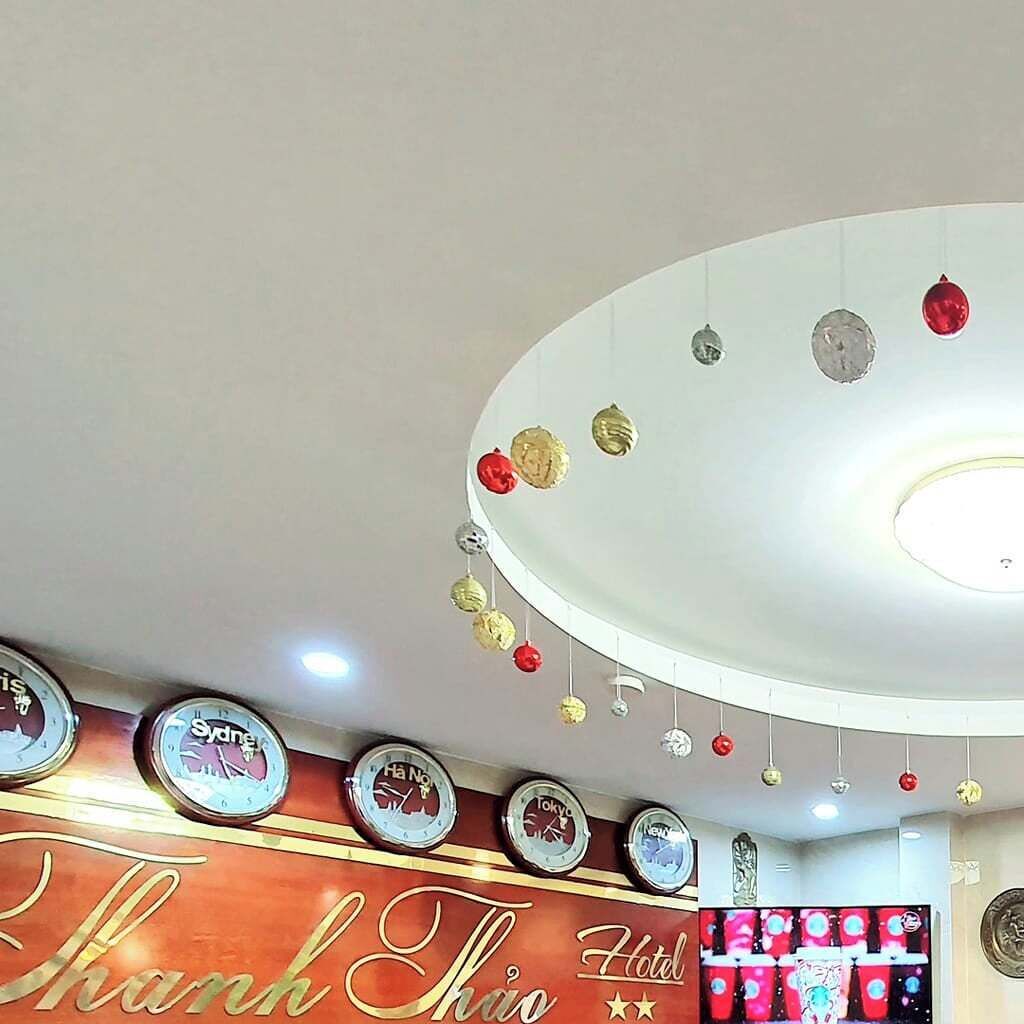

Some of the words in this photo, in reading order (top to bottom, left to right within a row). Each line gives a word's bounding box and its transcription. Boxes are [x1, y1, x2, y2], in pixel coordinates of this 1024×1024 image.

[536, 797, 573, 818] Tokyo
[0, 831, 365, 1017] Thanh
[345, 886, 558, 1024] Thảo
[577, 925, 687, 980] Hotel
